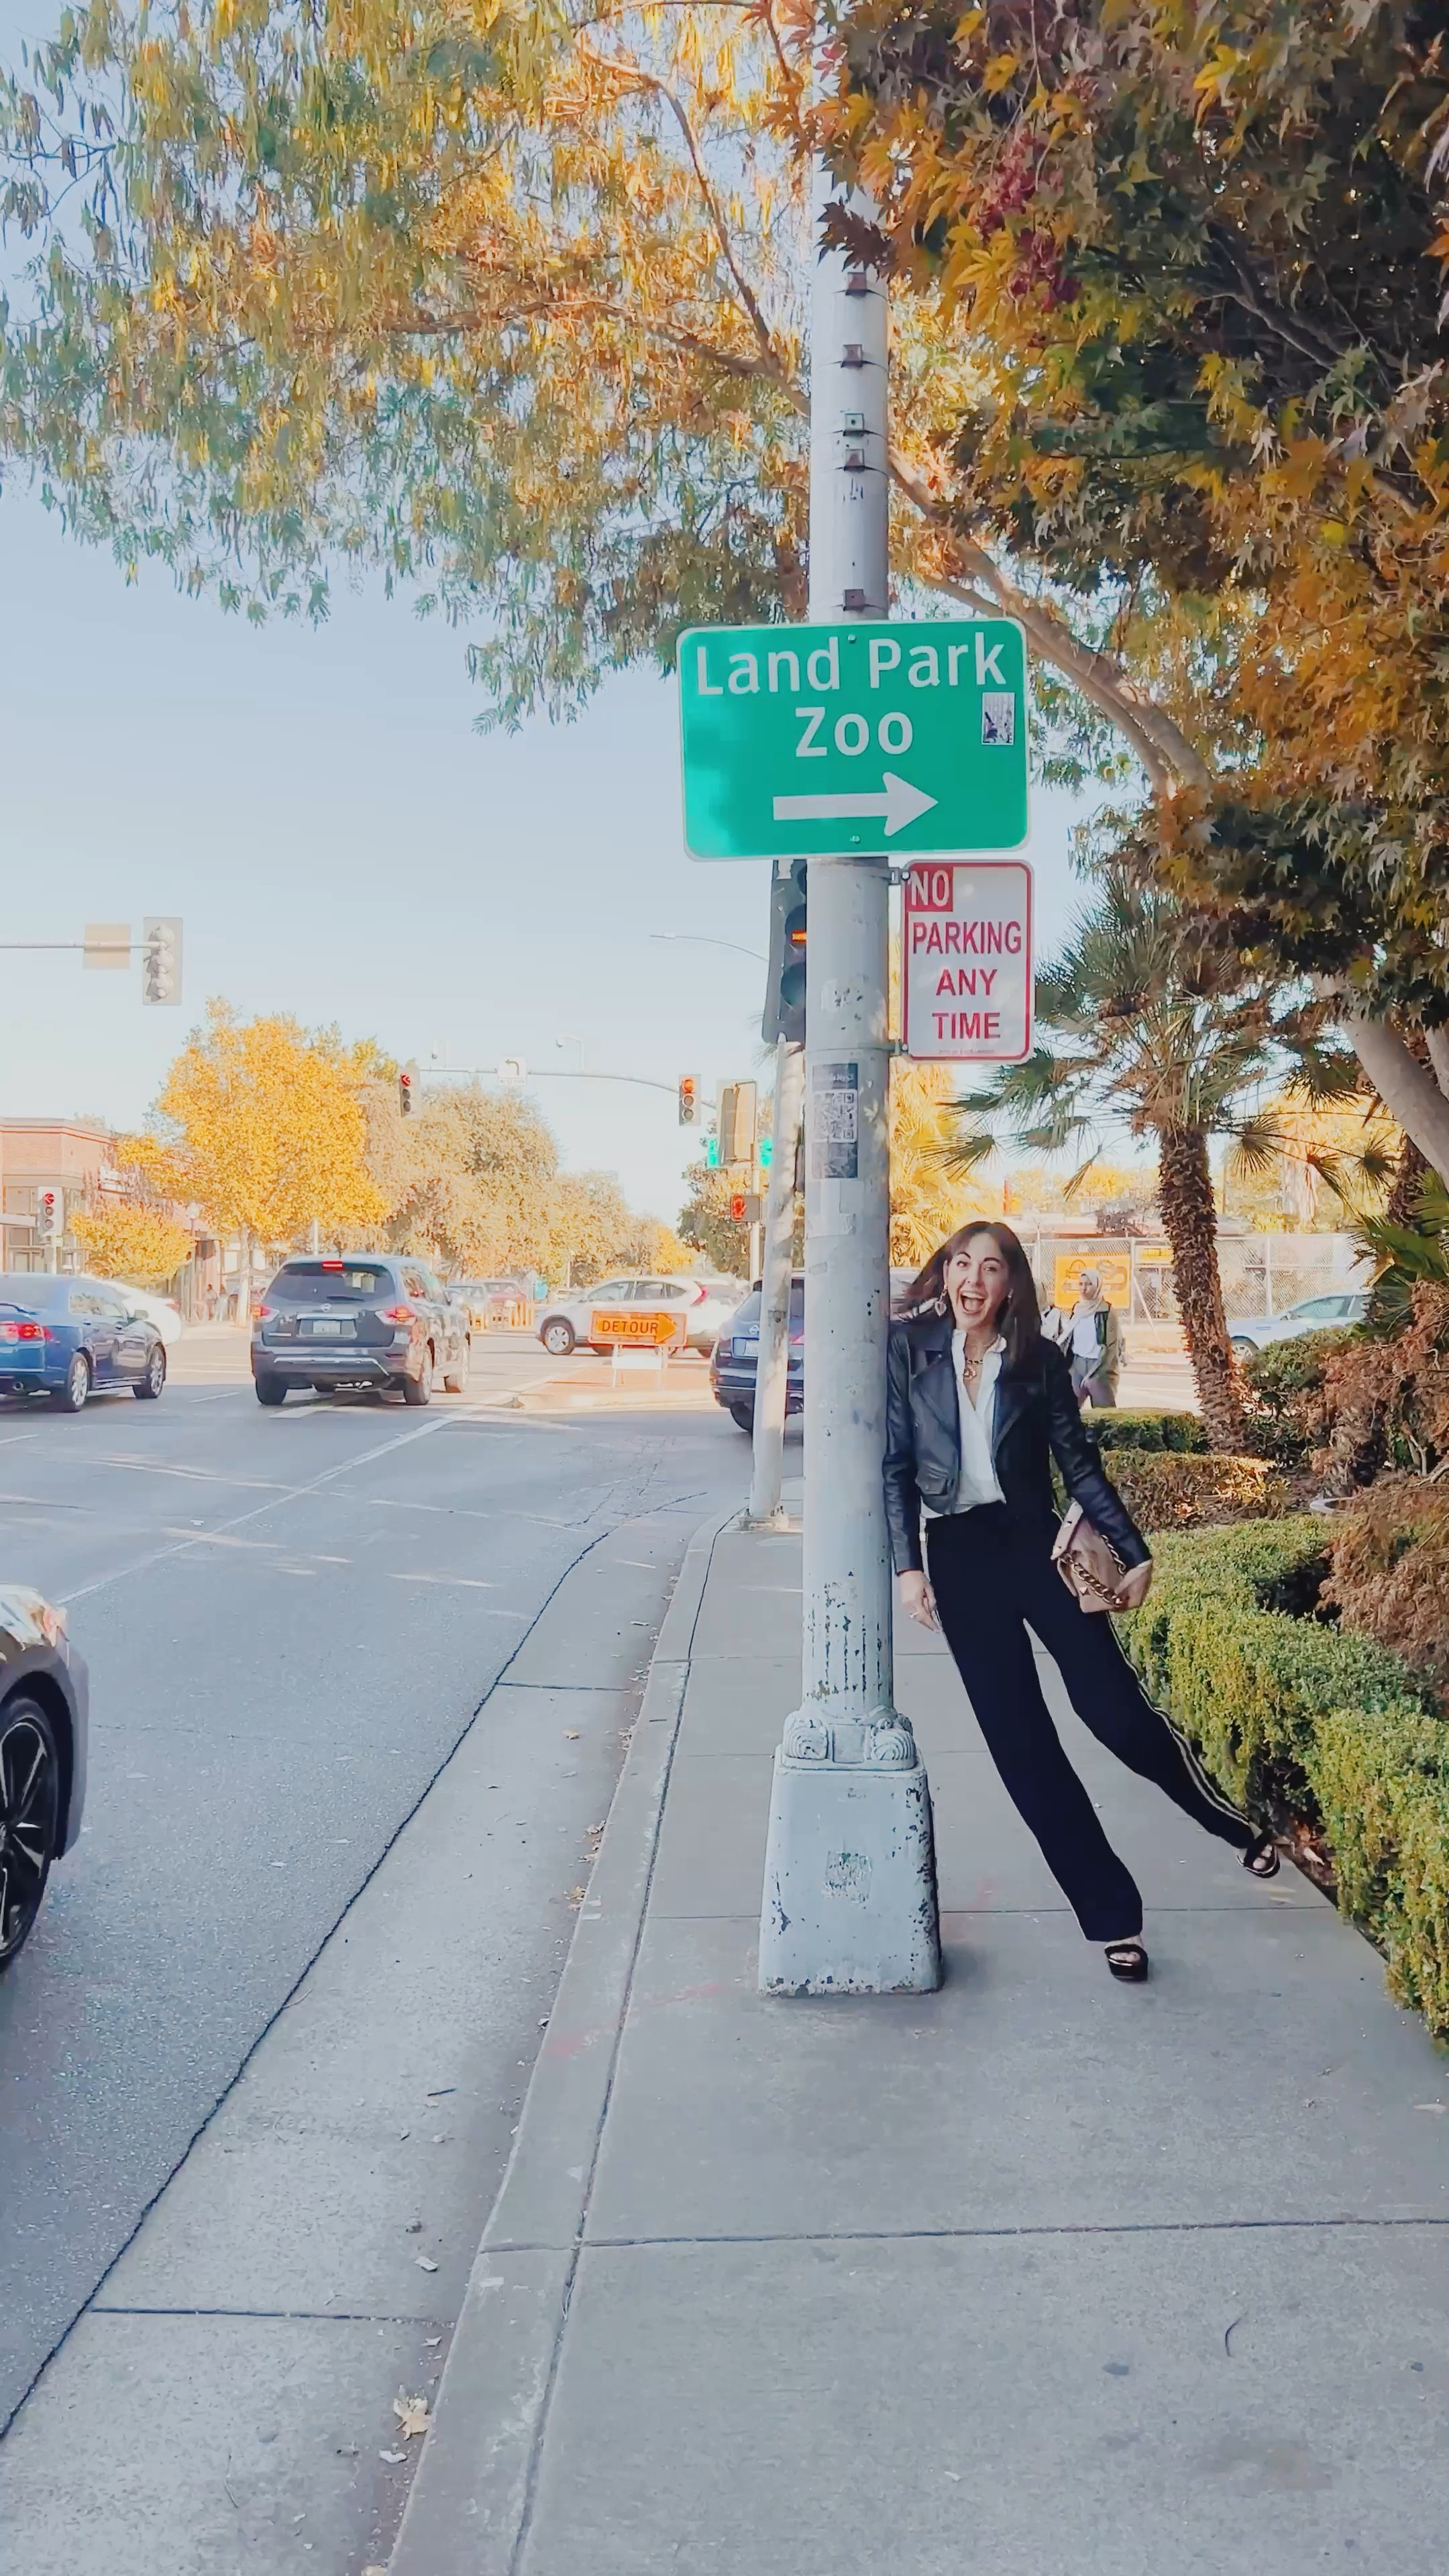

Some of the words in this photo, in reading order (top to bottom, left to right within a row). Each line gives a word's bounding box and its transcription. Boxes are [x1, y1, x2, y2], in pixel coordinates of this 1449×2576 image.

[696, 636, 840, 696] Land
[869, 632, 1006, 688] Park
[795, 706, 913, 757] Zoo
[910, 869, 951, 907] NO
[912, 920, 1022, 954] PARKING
[936, 969, 998, 996] ANY
[932, 1012, 1001, 1040] TIME
[602, 1320, 659, 1334] DETOUR
